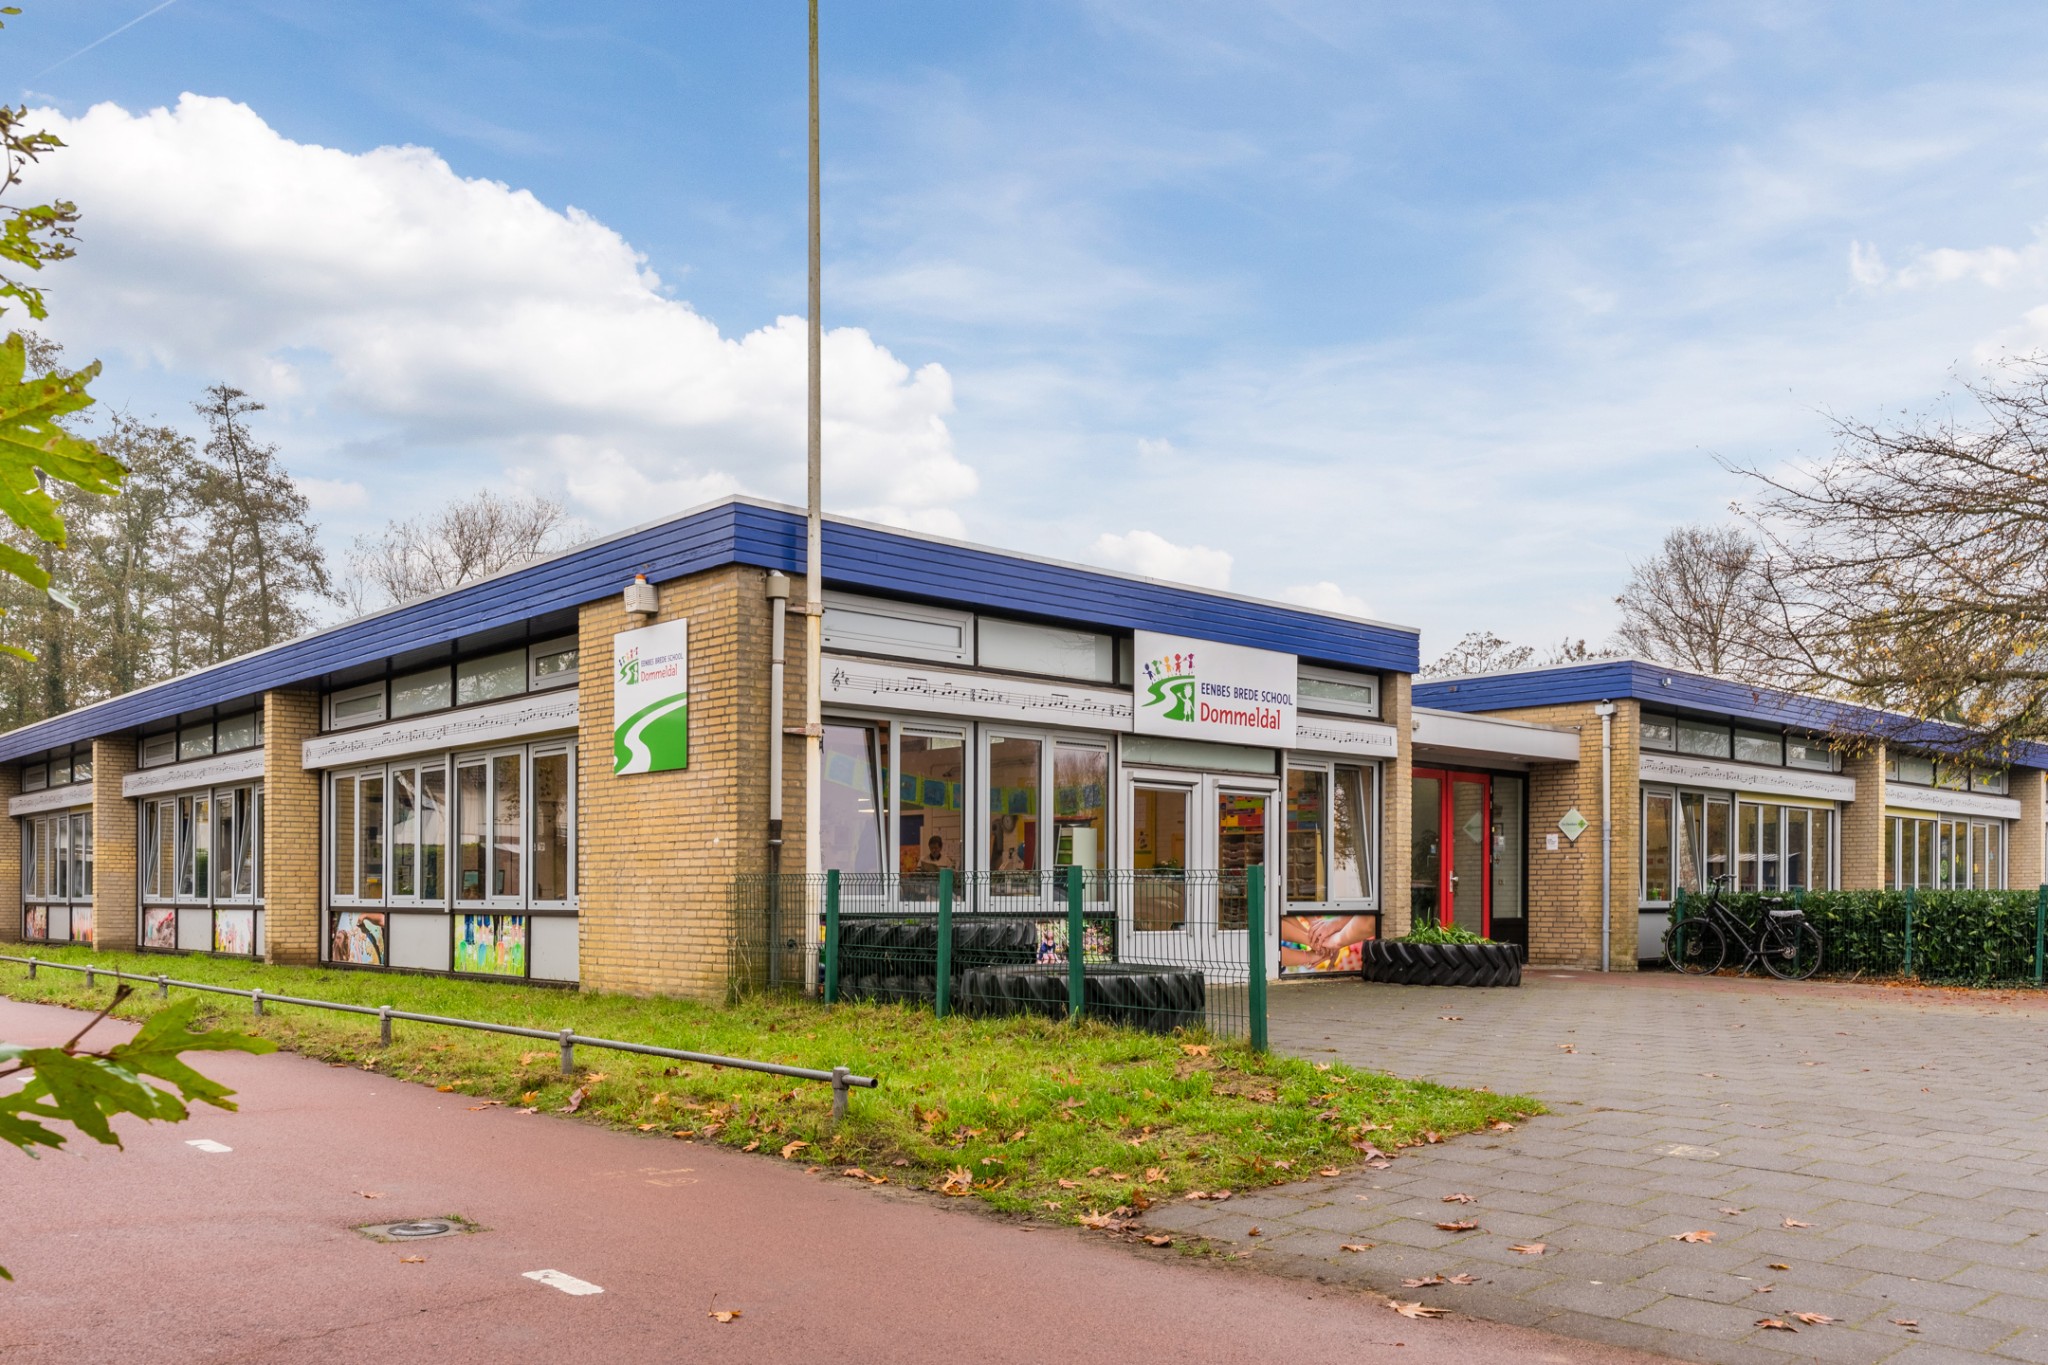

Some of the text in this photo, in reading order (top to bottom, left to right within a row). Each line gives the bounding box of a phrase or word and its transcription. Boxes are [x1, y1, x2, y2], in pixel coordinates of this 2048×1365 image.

[641, 663, 678, 682] Dommeldal
[1201, 682, 1293, 706] EENBES BREDE SCHOOL
[1200, 702, 1281, 730] Dommeldal
